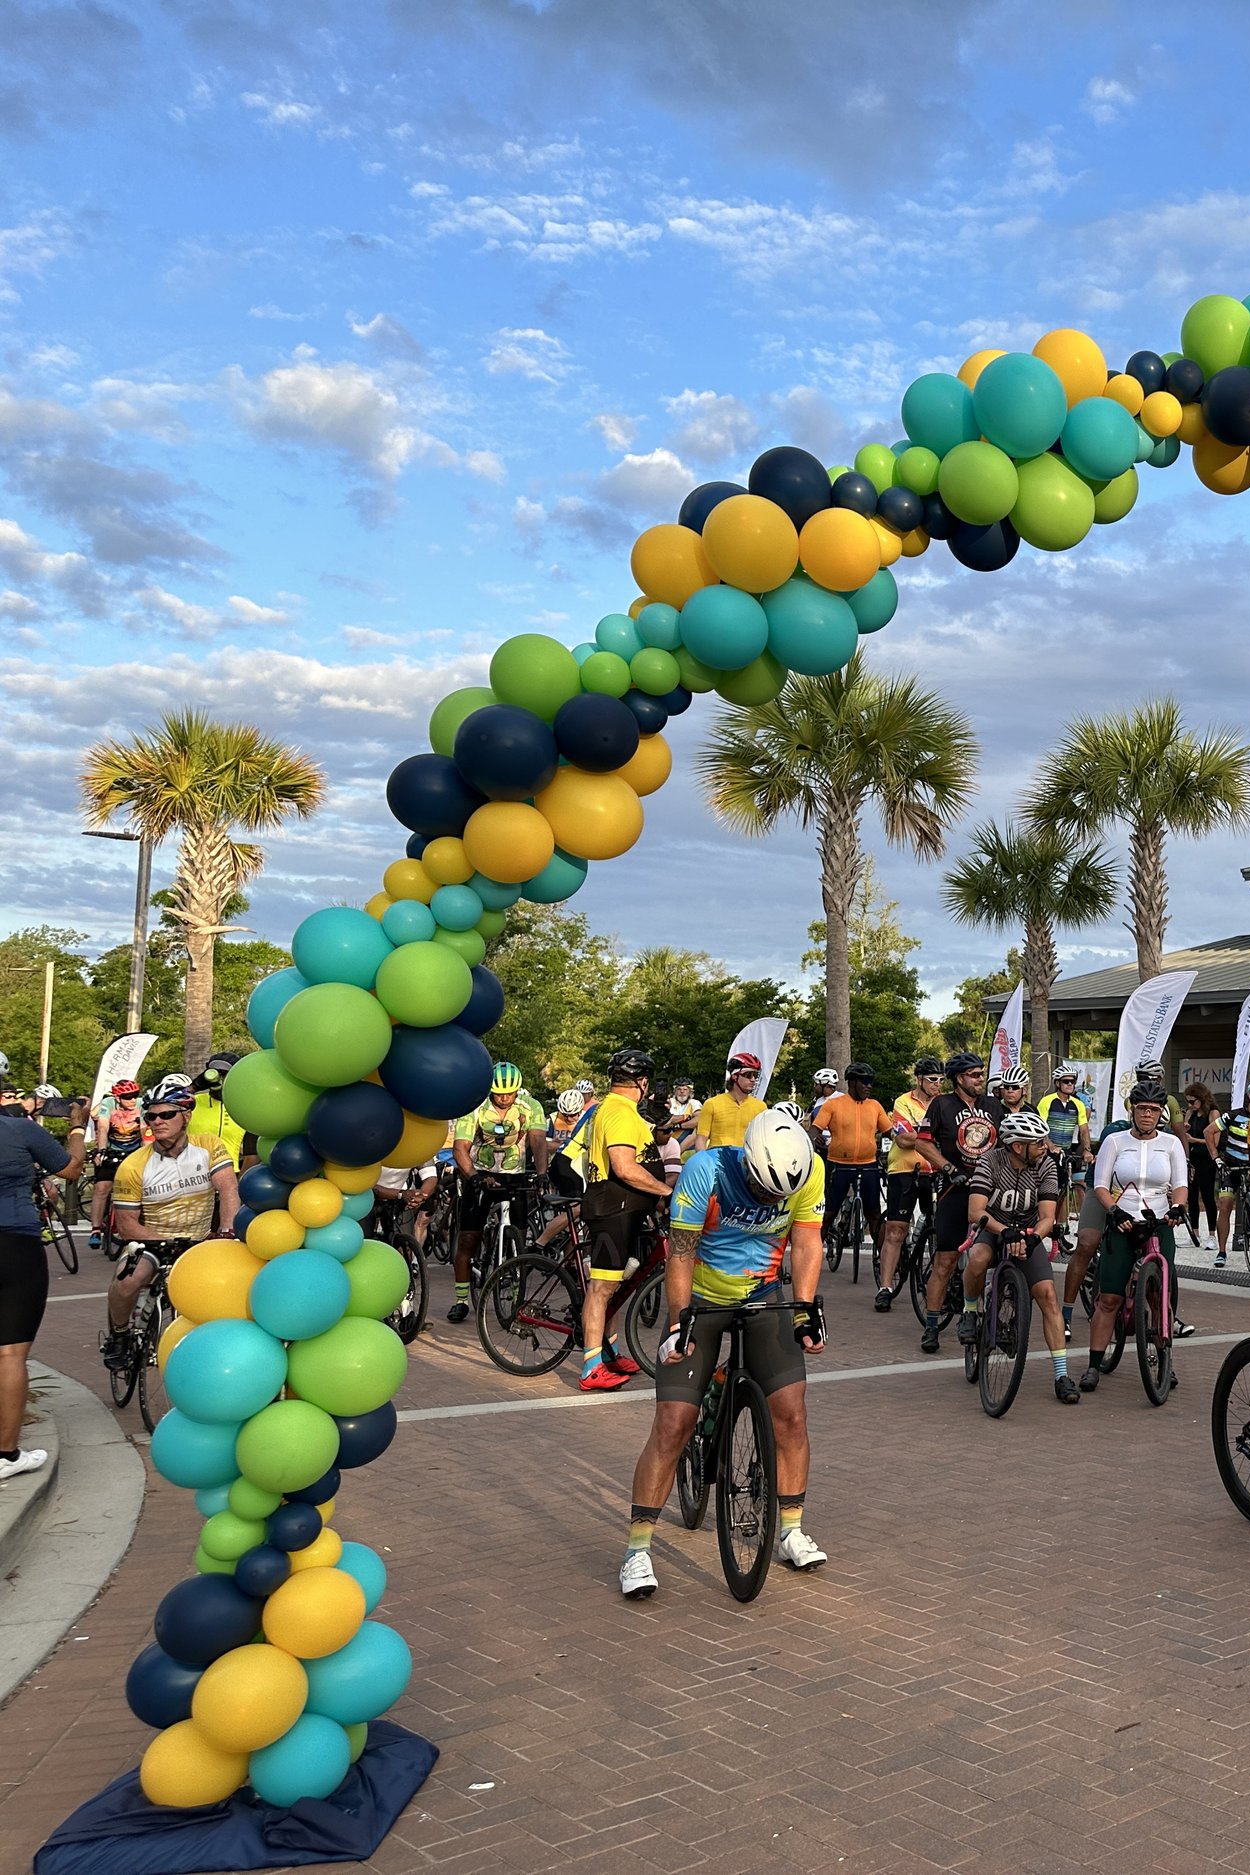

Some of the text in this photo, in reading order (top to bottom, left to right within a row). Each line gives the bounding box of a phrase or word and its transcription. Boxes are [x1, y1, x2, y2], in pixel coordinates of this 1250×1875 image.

[122, 1039, 140, 1062] DAVIS
[1183, 1066, 1232, 1084] THANK
[955, 1107, 994, 1125] USMC
[143, 1172, 212, 1197] SMITH GARDNE
[727, 1199, 790, 1225] PEDAL
